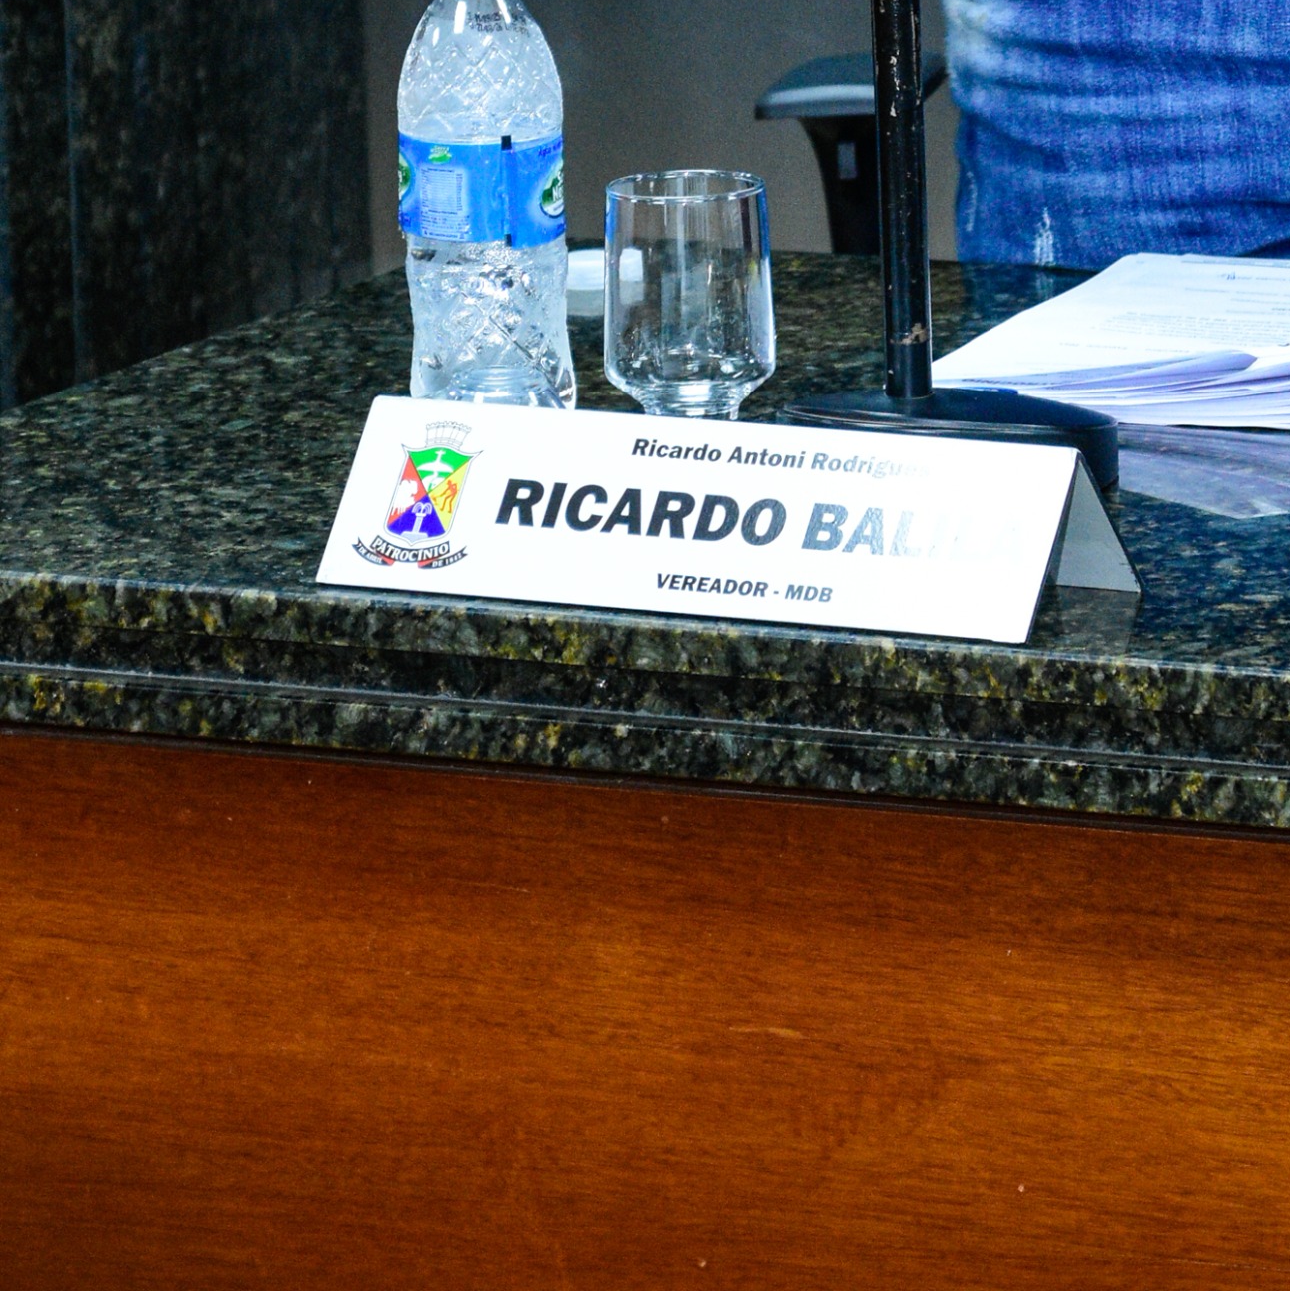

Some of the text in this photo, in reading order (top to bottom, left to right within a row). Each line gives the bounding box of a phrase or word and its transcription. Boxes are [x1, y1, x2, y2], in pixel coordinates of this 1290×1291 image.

[631, 437, 722, 462] Ricardo
[727, 445, 806, 469] Antoni
[495, 477, 787, 546] RICARDO
[657, 573, 769, 598] VEREADOR
[784, 584, 833, 603] MDB
